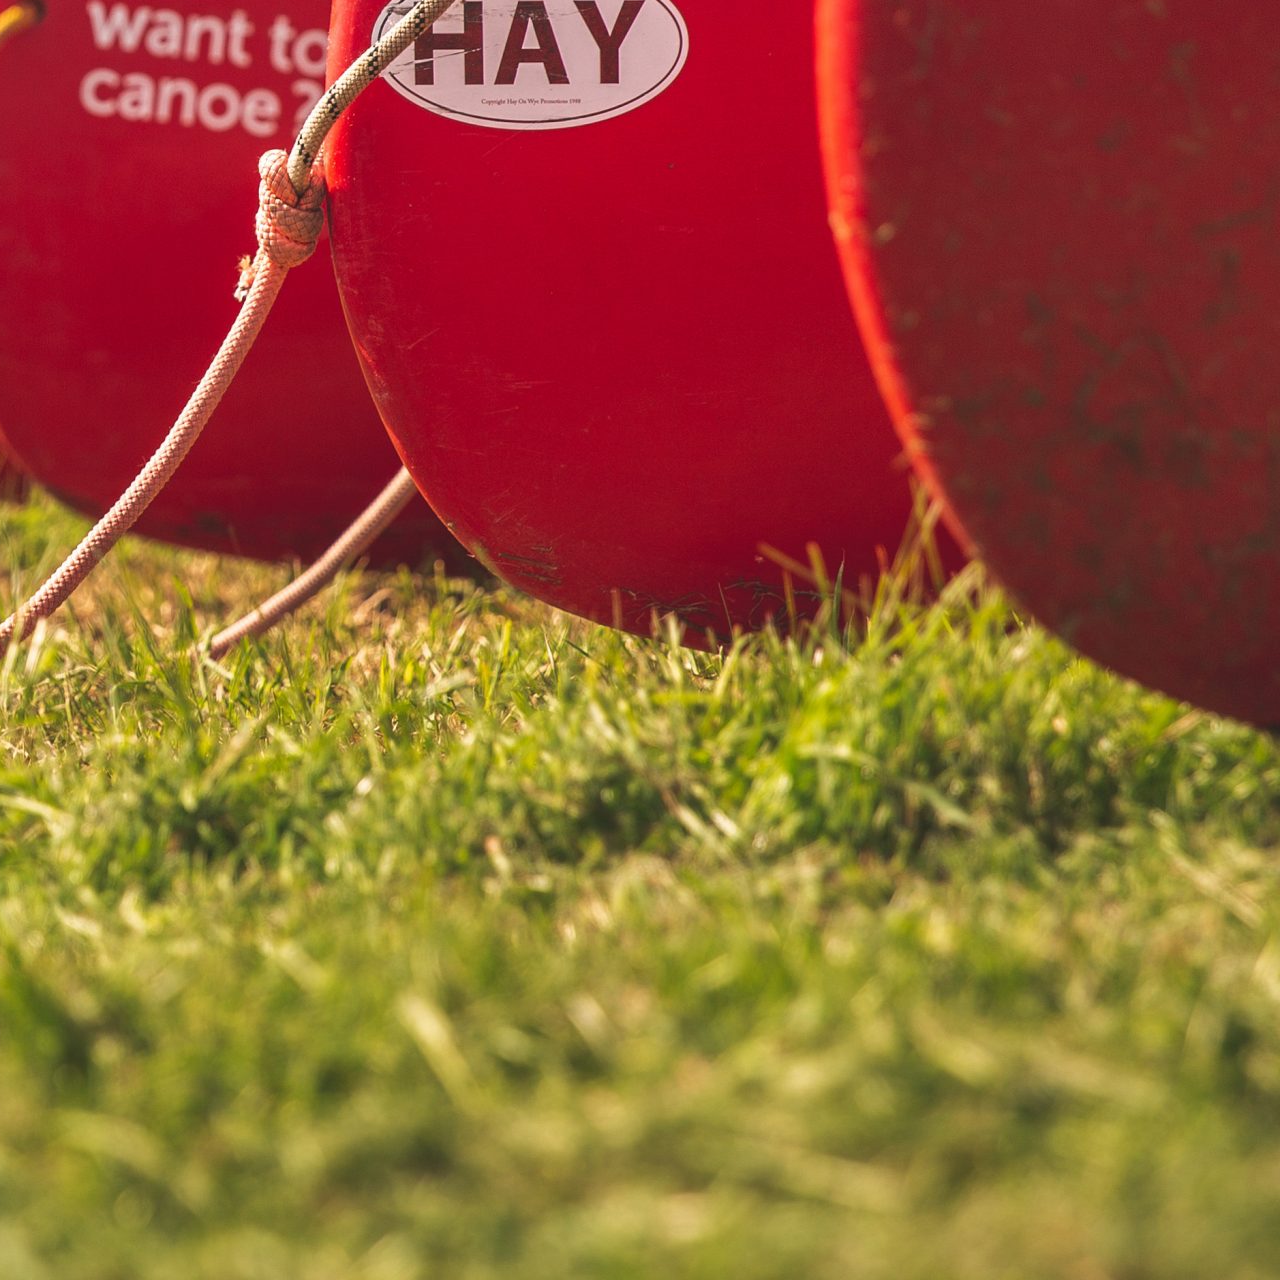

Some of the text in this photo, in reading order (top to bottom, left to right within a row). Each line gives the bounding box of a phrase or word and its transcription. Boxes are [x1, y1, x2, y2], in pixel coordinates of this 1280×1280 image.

[86, 0, 329, 78] want to
[414, 0, 645, 86] HAY
[79, 67, 281, 138] canoe
[481, 98, 505, 106] Copyright
[507, 98, 517, 106] Hay
[528, 98, 539, 106] Wye
